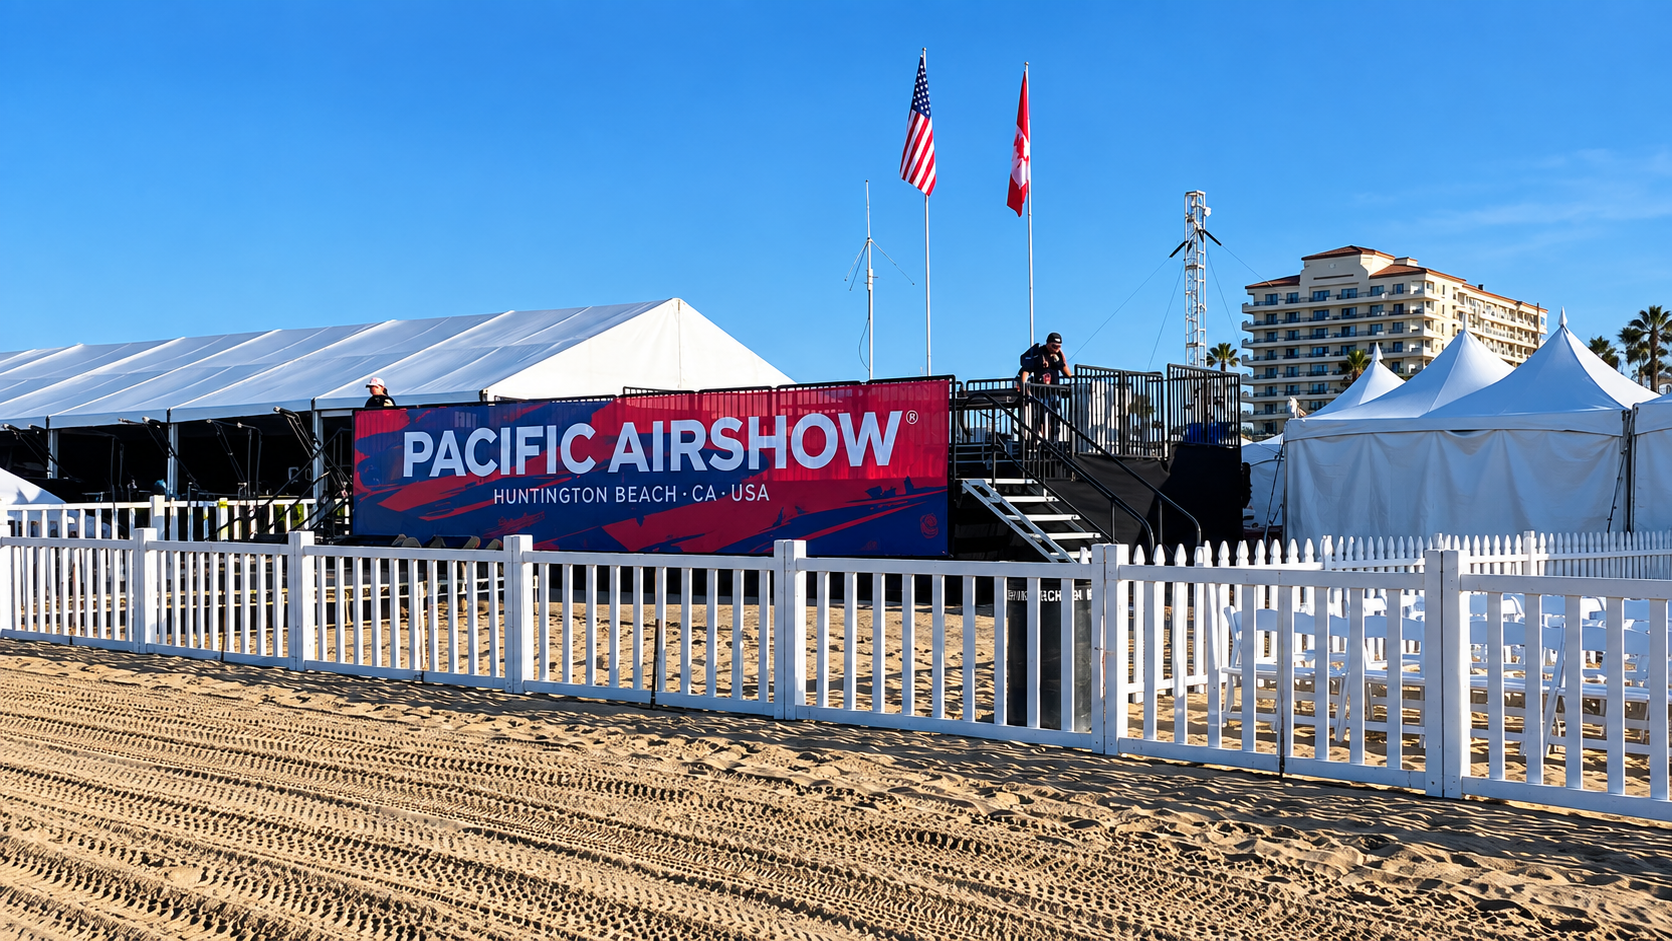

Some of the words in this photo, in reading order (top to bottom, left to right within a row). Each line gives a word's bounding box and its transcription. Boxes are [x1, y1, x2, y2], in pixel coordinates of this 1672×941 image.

[403, 423, 597, 478] PACIFIC
[607, 410, 903, 473] AIRSHOW
[494, 486, 608, 505] HUNTINGTON
[615, 484, 677, 503] BEACH
[692, 484, 717, 502] CA
[731, 484, 770, 502] USA
